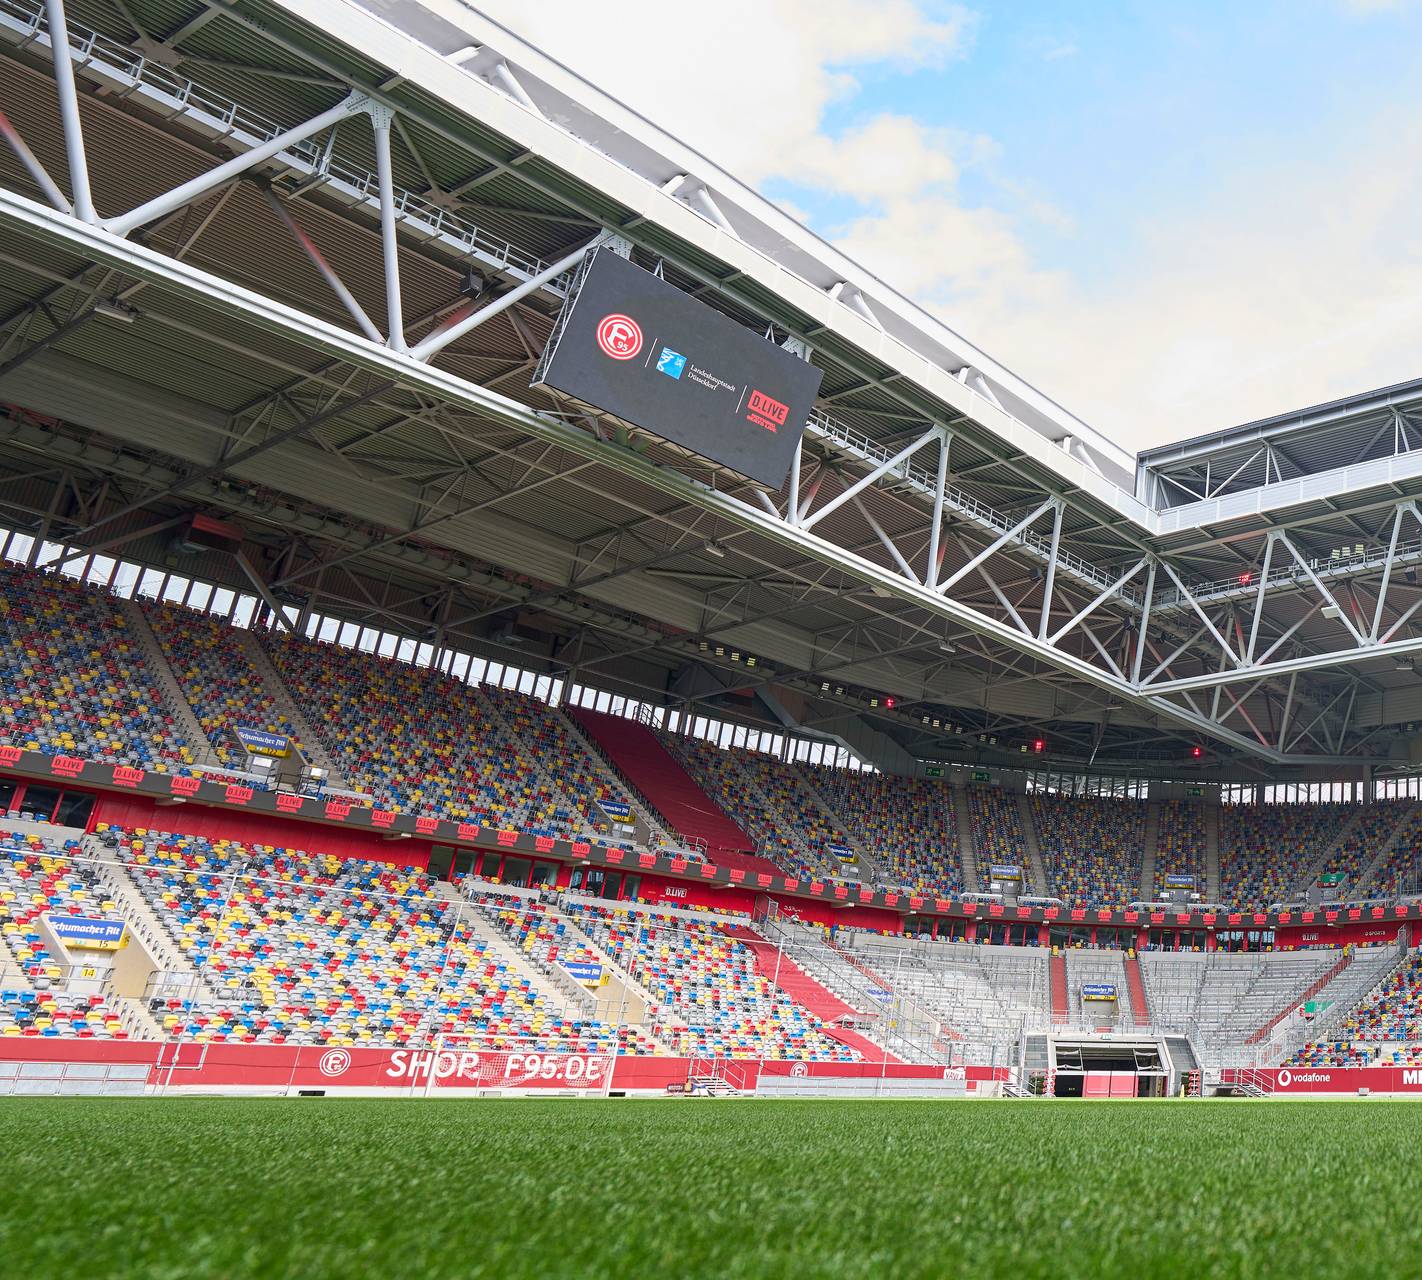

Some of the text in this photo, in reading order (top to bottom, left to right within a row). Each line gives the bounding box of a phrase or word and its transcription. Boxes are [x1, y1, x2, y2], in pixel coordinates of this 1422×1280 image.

[688, 372, 719, 391] Düsseldorf
[690, 364, 736, 392] Landeshauptstadt
[752, 394, 785, 420] D.LIVE
[54, 758, 82, 771] D.LIVE
[115, 768, 142, 780] D.LIVE
[173, 777, 198, 790] D.LIVE
[228, 786, 251, 798] D.LIVE
[279, 795, 302, 807] D.LIVE
[665, 887, 686, 897] D.LIVE
[105, 926, 120, 935] Alt
[1293, 1073, 1331, 1082] vodafone
